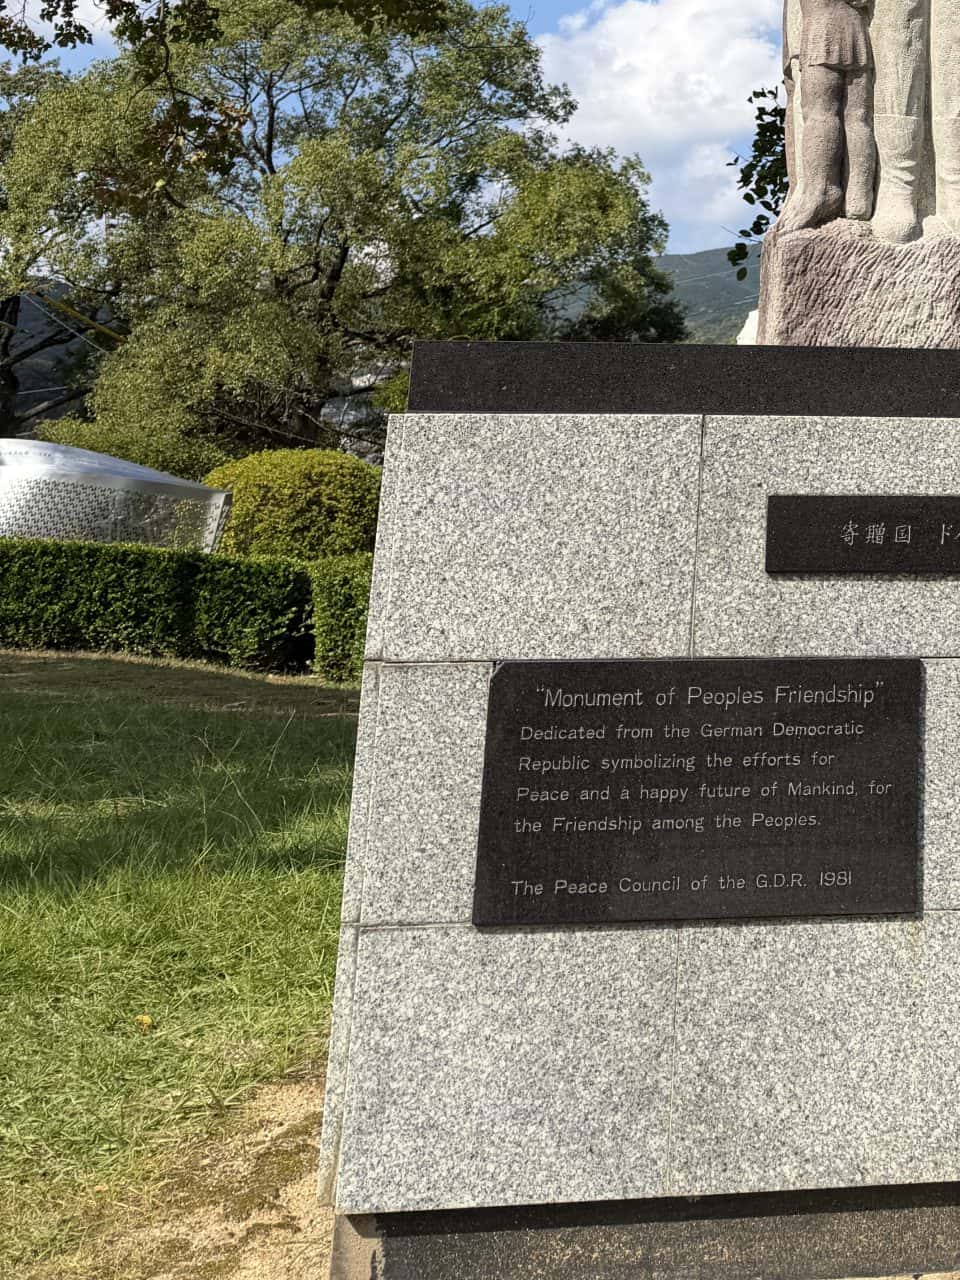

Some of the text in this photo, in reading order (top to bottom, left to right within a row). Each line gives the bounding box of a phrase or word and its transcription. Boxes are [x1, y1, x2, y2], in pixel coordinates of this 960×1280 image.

[839, 520, 912, 545] 寄贈国
[655, 687, 676, 705] of
[687, 686, 764, 710] Peoples
[520, 720, 865, 741] Dedicated from the German Democratic
[518, 751, 836, 774] Republic symbolizing the efforts for
[516, 780, 892, 802] Peace and a happy future of Mankind, for
[513, 812, 821, 835] the Friendship among the Peoples.
[512, 871, 852, 897] The Peace Council of the G.D.R. 1981
